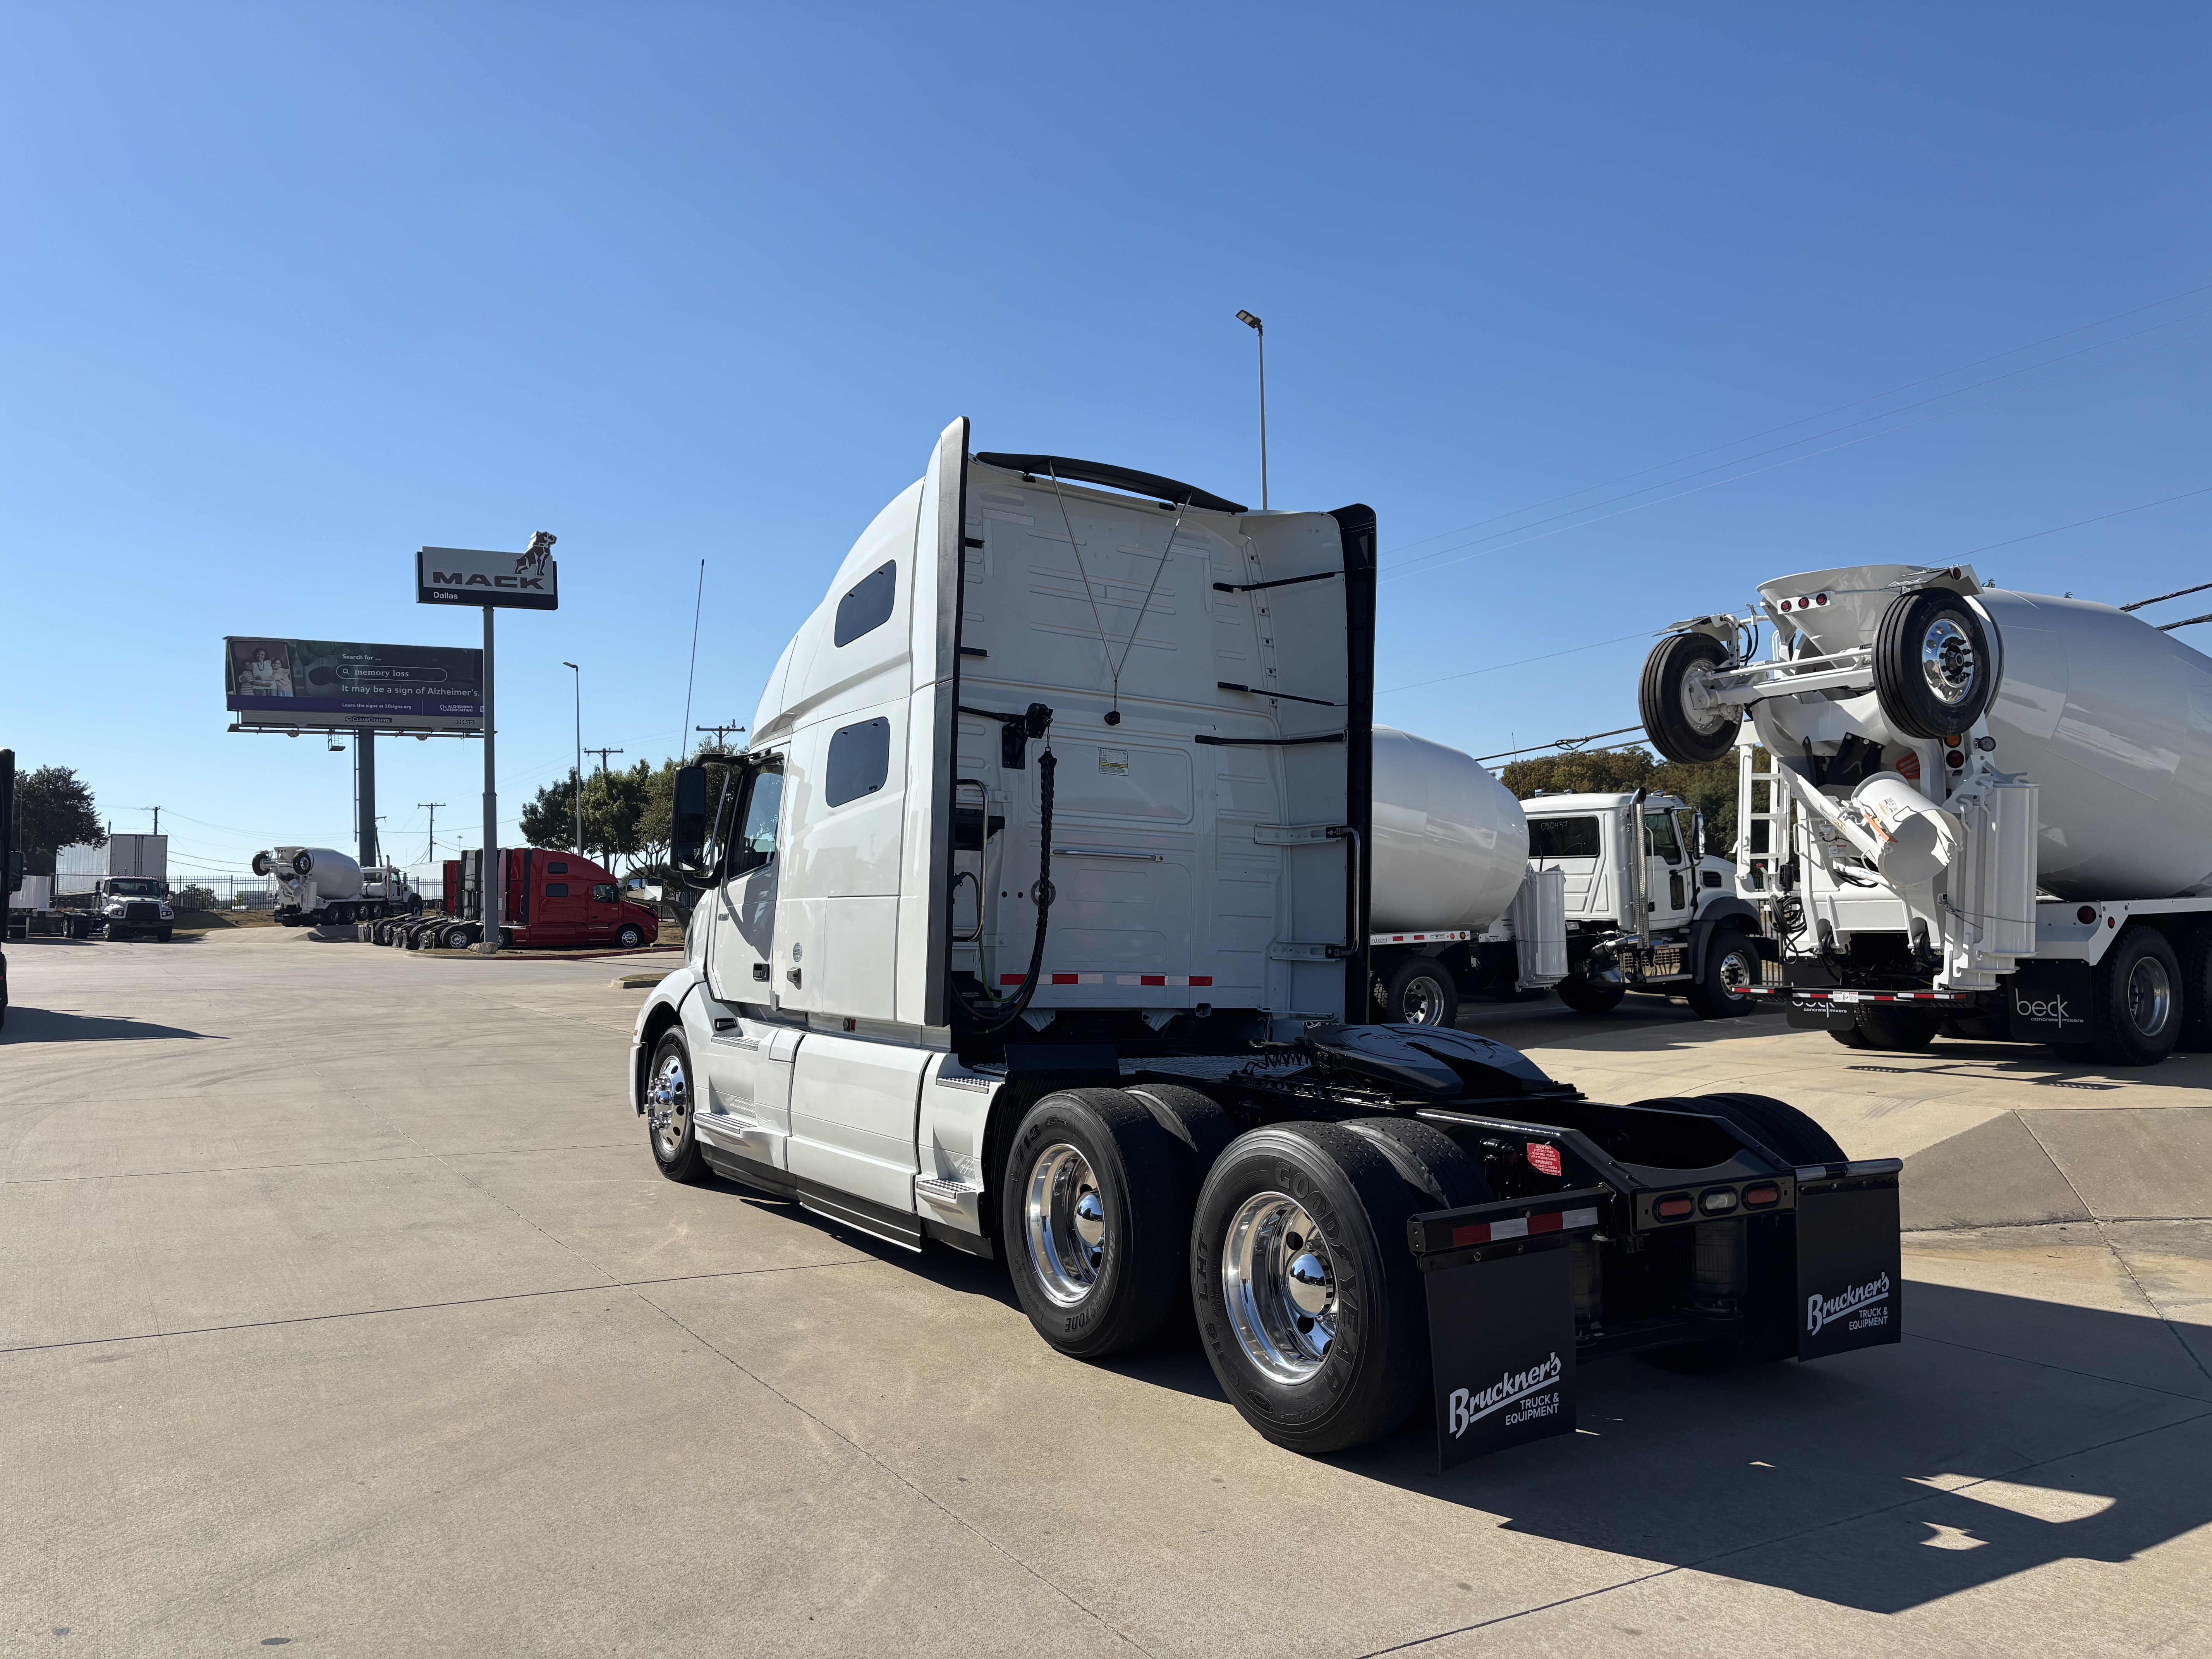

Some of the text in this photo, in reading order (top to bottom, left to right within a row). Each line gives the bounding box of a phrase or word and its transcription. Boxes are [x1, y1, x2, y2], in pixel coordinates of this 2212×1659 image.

[433, 571, 545, 590] MACK
[354, 669, 390, 678] memory
[352, 686, 370, 694] may
[395, 685, 412, 696] sign
[427, 687, 480, 696] Alzheimer's.
[2015, 988, 2069, 1029] beck
[1197, 1233, 1209, 1302] LHT
[1274, 1162, 1358, 1395] GOODYEAR
[1065, 1230, 1116, 1332] BRIDGESTONE
[1807, 1271, 1890, 1336] Bruckner's
[1859, 1307, 1888, 1319] TRUCK &
[1849, 1316, 1888, 1330] EQUIPMENT
[1449, 1352, 1561, 1439] Bruckner's
[1520, 1393, 1559, 1410] TRUCK &
[1506, 1403, 1559, 1425] EQUIPMENT
